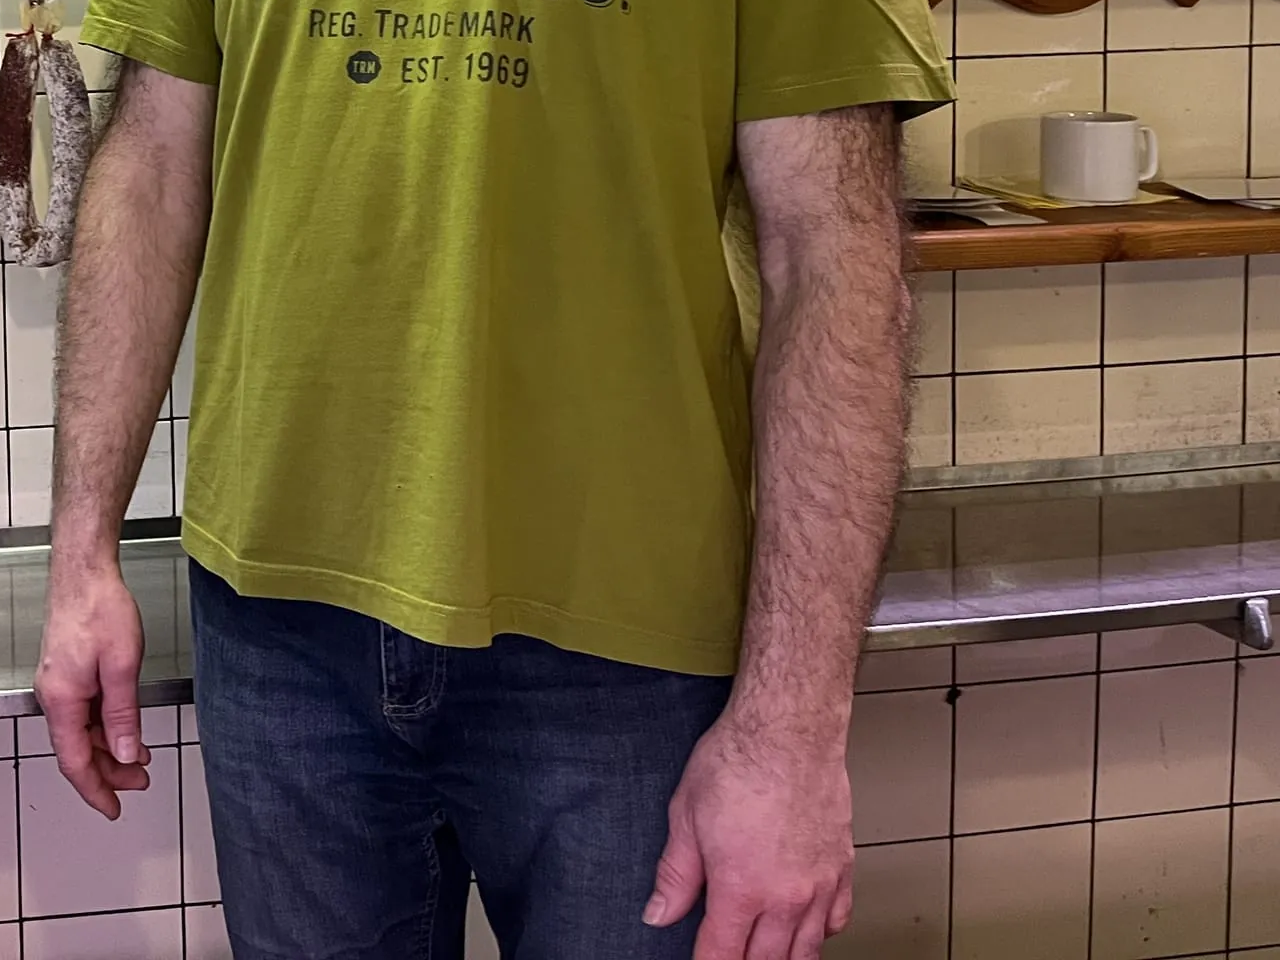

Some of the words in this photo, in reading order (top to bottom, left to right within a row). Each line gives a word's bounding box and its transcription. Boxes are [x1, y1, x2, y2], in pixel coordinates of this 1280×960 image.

[309, 8, 363, 38] REG.
[402, 55, 449, 84] EST.
[465, 52, 529, 87] 1969
